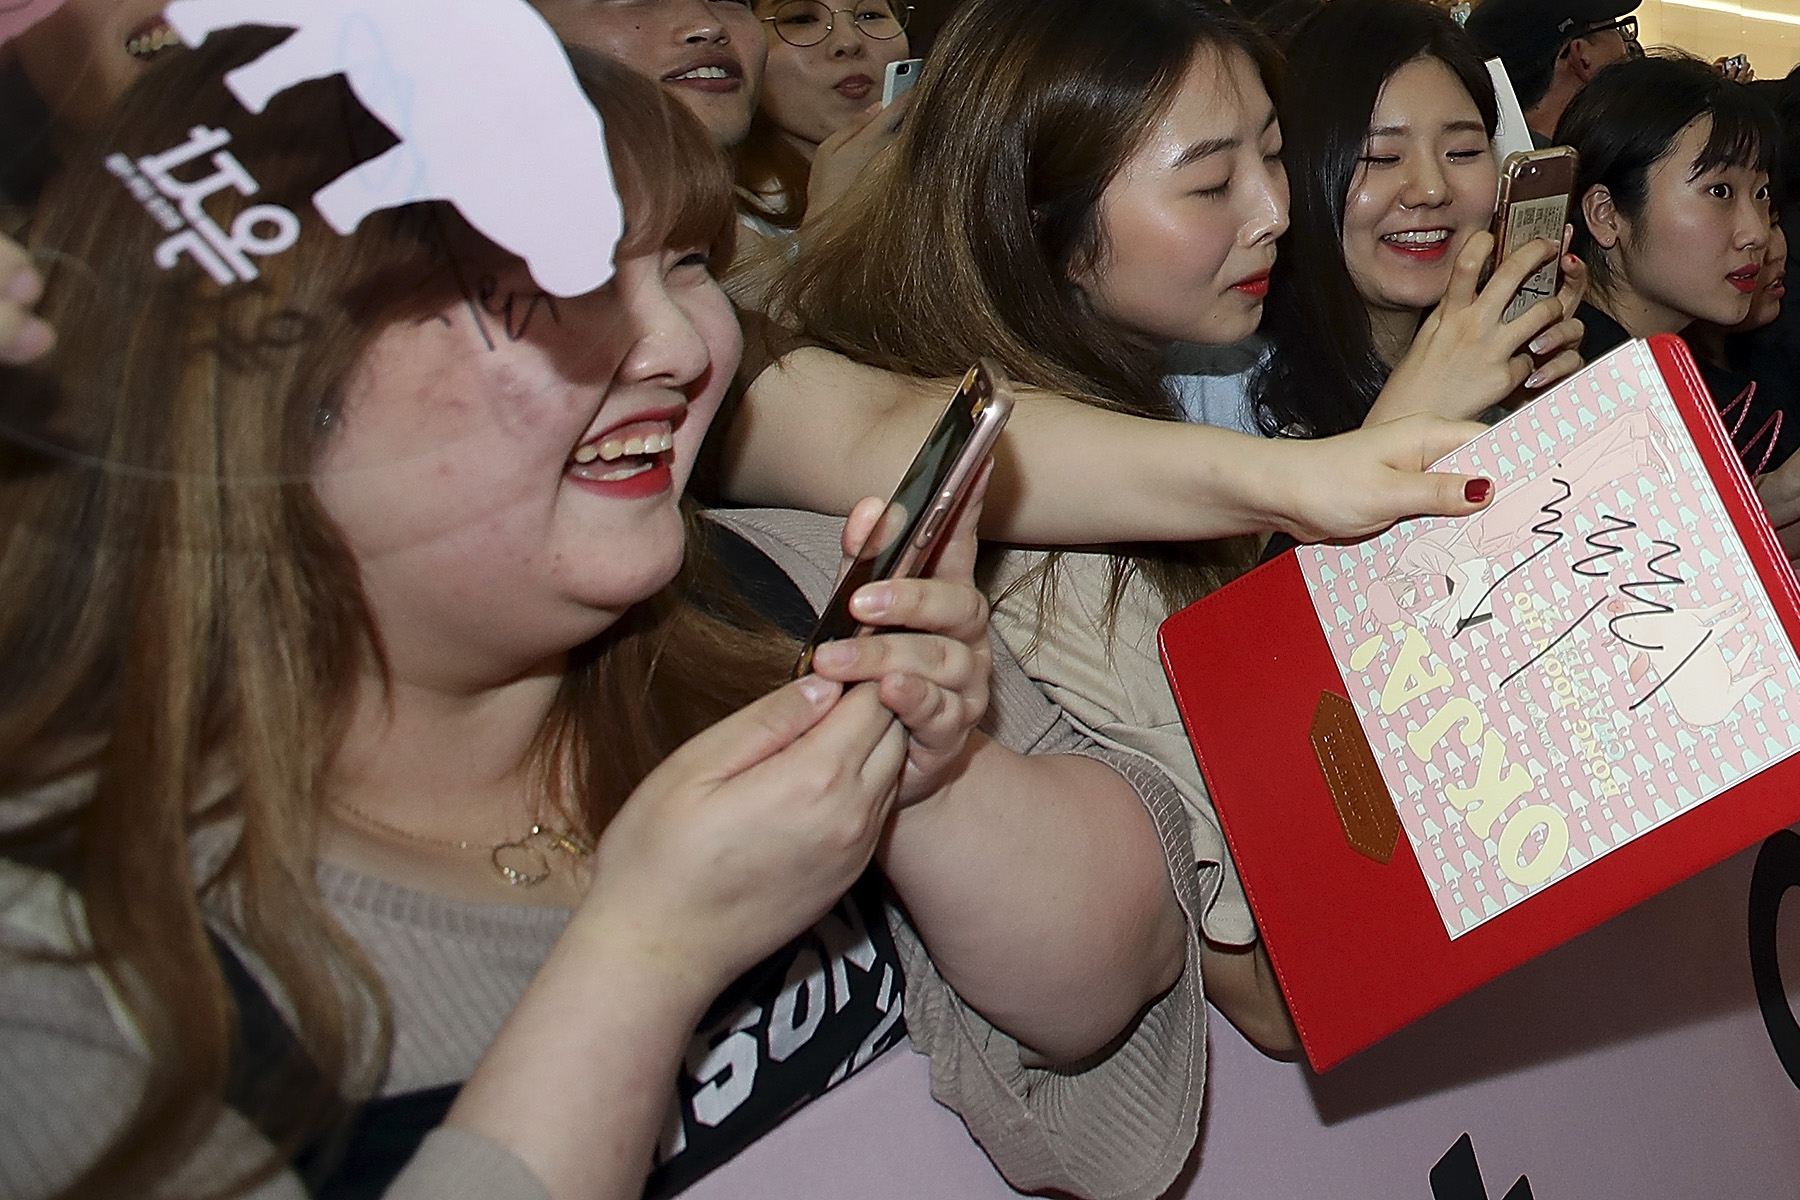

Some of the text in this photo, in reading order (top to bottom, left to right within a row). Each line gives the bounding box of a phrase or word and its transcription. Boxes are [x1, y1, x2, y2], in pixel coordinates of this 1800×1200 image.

[1514, 591, 1621, 800] BONG JOON HO
